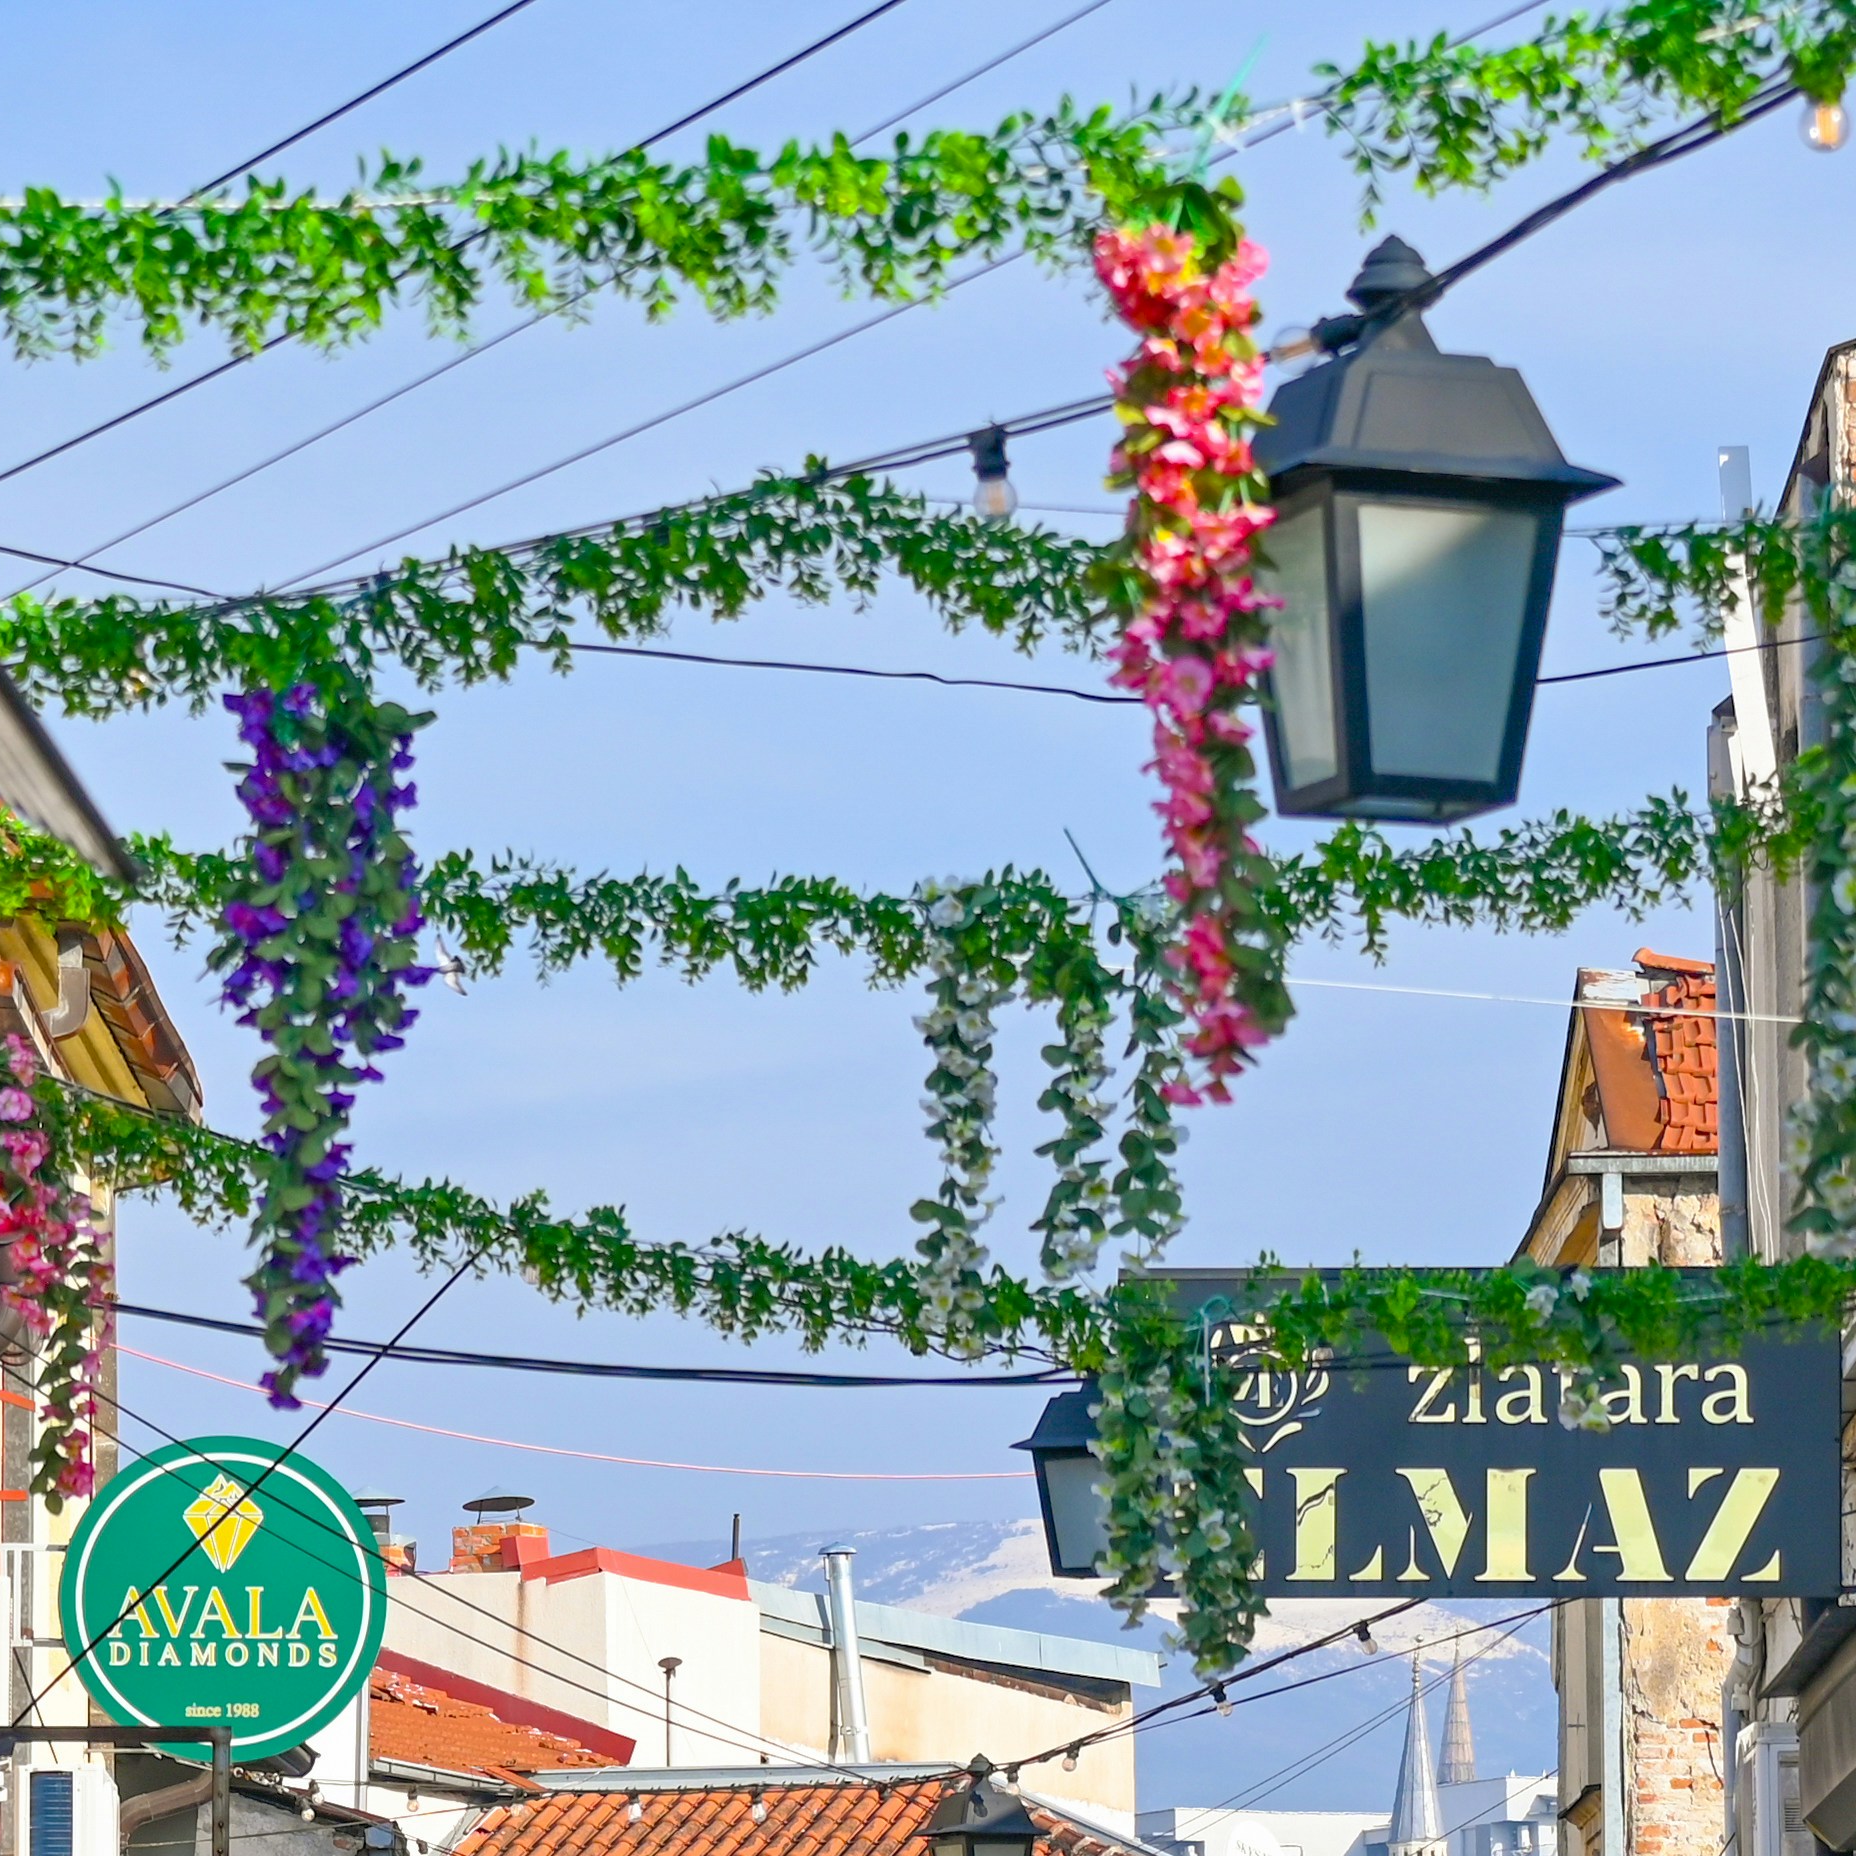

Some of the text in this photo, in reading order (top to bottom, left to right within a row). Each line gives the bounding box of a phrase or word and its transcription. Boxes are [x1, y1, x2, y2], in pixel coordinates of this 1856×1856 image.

[107, 1585, 339, 1640] AVALA
[108, 1641, 338, 1668] DIAMONDS
[185, 1703, 260, 1718] since 1988
